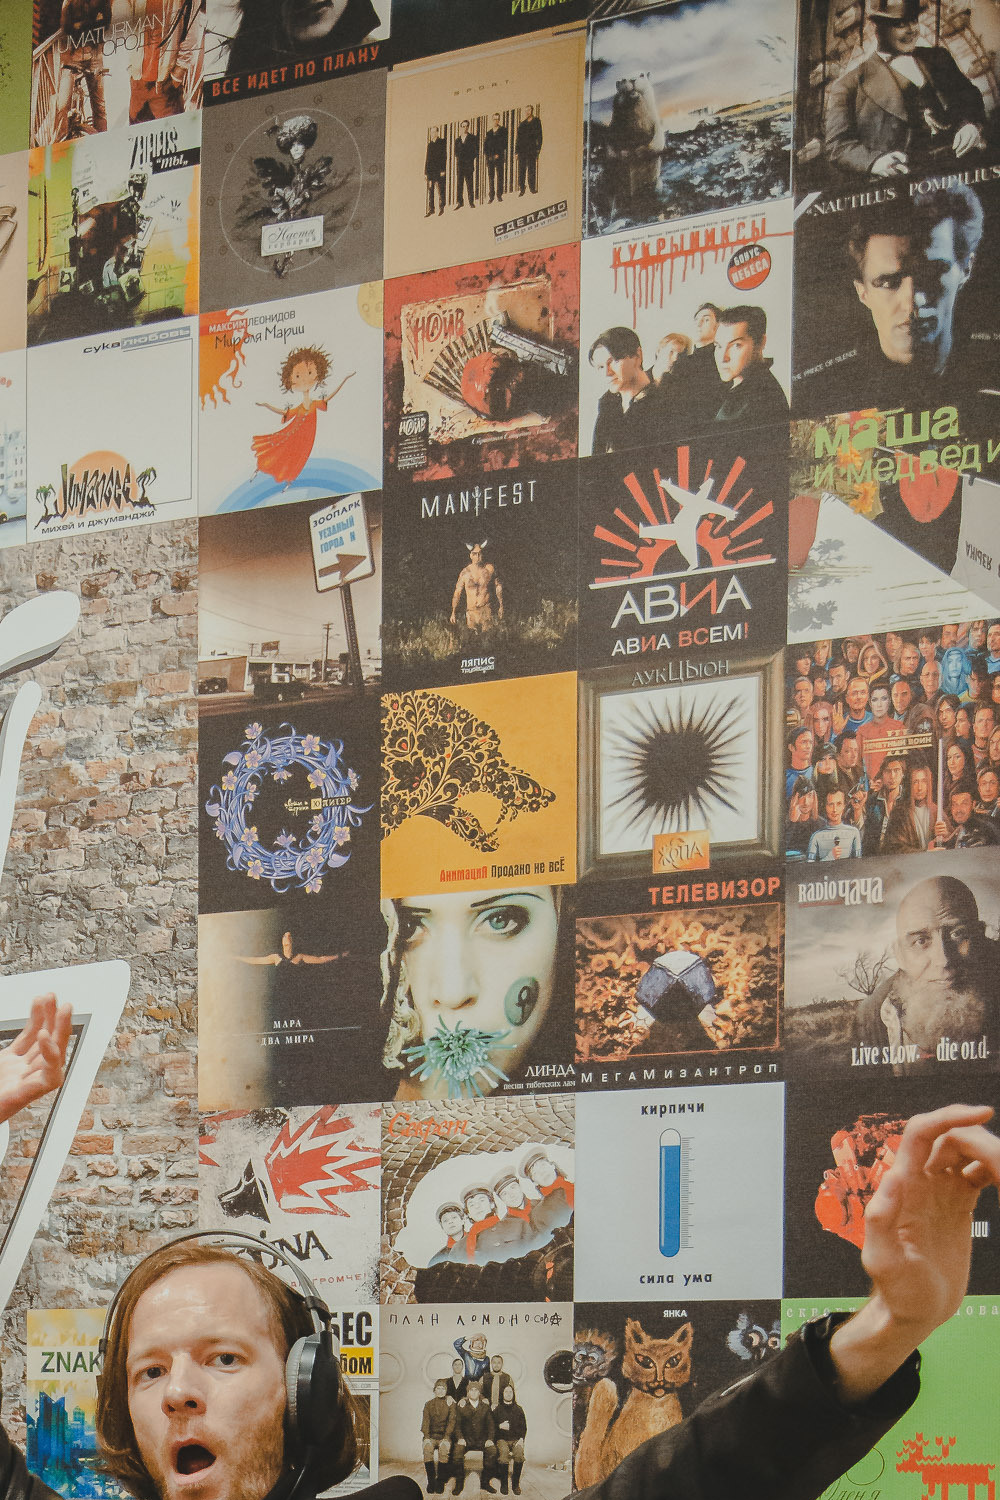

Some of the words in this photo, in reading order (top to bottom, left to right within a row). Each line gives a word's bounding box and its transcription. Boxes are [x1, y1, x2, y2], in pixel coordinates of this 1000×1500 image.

[212, 77, 240, 97] ВСЕ
[247, 67, 288, 90] ИДЕТ
[294, 62, 316, 80] ПО
[322, 45, 381, 73] ПЛАНУ
[208, 319, 248, 334] МАКСИМ
[247, 310, 297, 327] ЛЕОНИДОВ
[263, 325, 305, 345] Марии
[814, 406, 960, 460] маша
[41, 521, 76, 535] михей
[77, 520, 85, 529] и
[87, 509, 156, 529] джуманджи
[312, 499, 362, 528] ЗООПАРК
[610, 574, 752, 629] АВИА
[610, 635, 672, 657] АВИА
[678, 622, 750, 648] ВСЕМ!
[460, 656, 496, 669] ЛЯПИС
[534, 862, 546, 875] не
[647, 875, 781, 906] ТЕЛЕВИЗОР
[272, 1018, 303, 1029] МАРА
[284, 1033, 316, 1046] МИРА
[524, 1063, 577, 1078] ЛИНДА
[503, 1082, 524, 1090] песни
[526, 1080, 561, 1090] тибетских
[562, 1079, 576, 1088] лам
[640, 1100, 706, 1119] кирпичи
[639, 1273, 675, 1285] сила
[682, 1272, 714, 1289] ума
[389, 1313, 440, 1327] ПЛАН
[662, 1309, 688, 1319] ЯНКА
